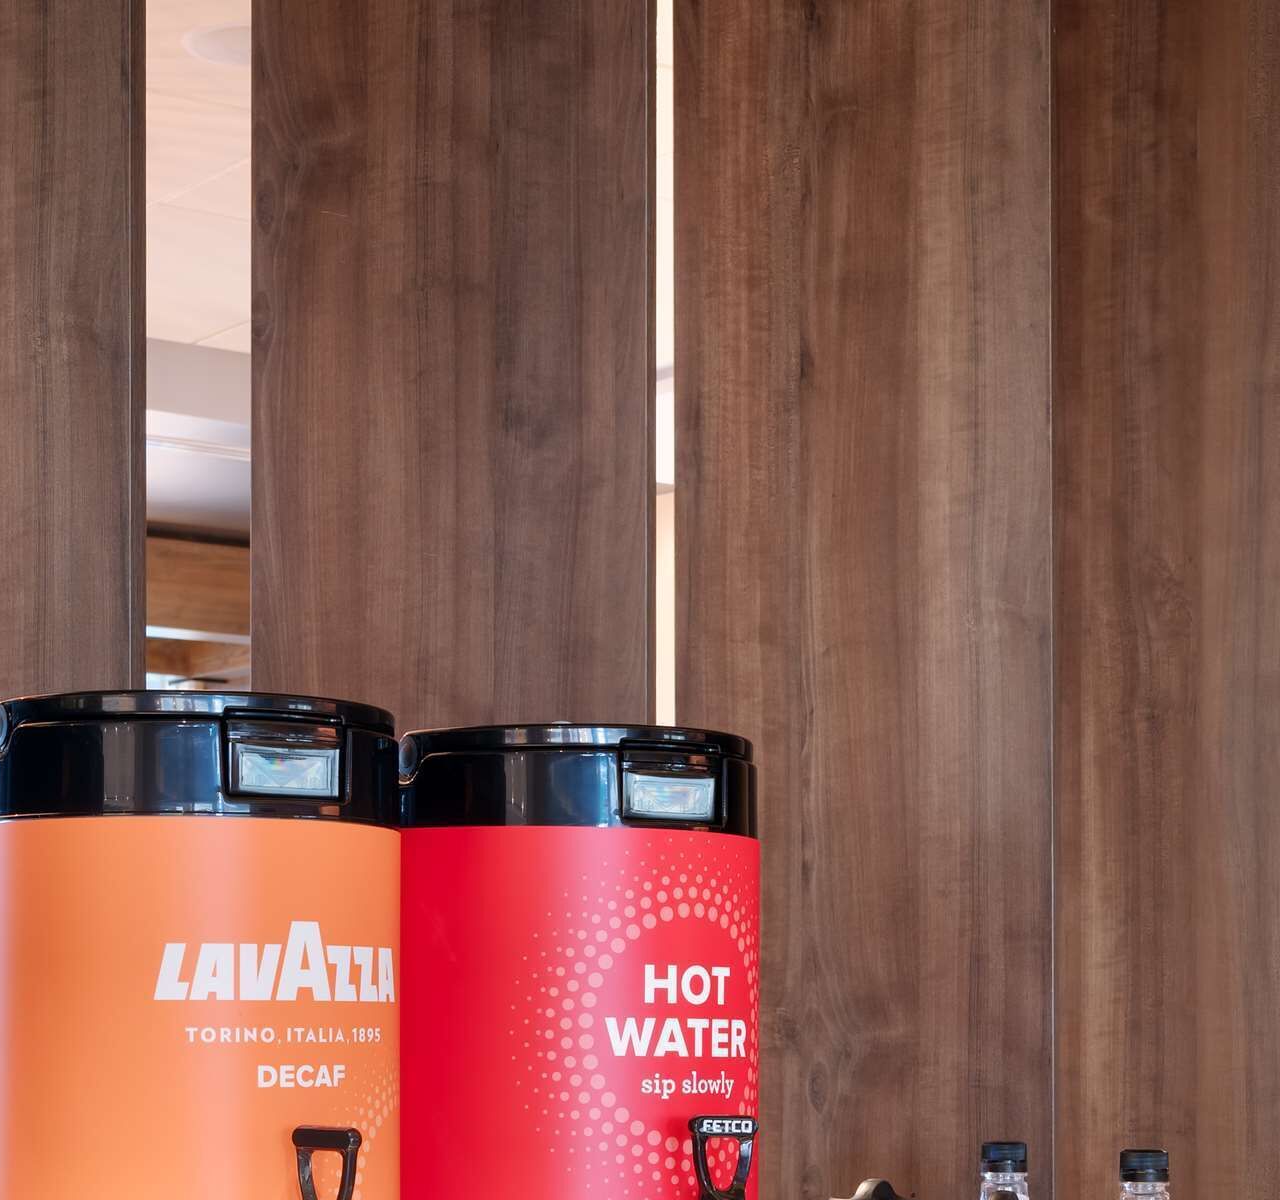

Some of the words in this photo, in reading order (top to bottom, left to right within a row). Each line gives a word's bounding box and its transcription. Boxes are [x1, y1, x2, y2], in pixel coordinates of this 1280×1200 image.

[154, 921, 395, 1003] LAVAZZA
[644, 964, 731, 1006] HOT
[185, 1027, 281, 1044] TORINO,
[286, 1027, 350, 1044] ITALIA,
[352, 1027, 381, 1043] 1895
[604, 1017, 746, 1058] WATER
[257, 1064, 346, 1088] DECAF
[641, 1072, 675, 1100] sip
[682, 1071, 734, 1099] slowly
[702, 1119, 753, 1133] FETCO
